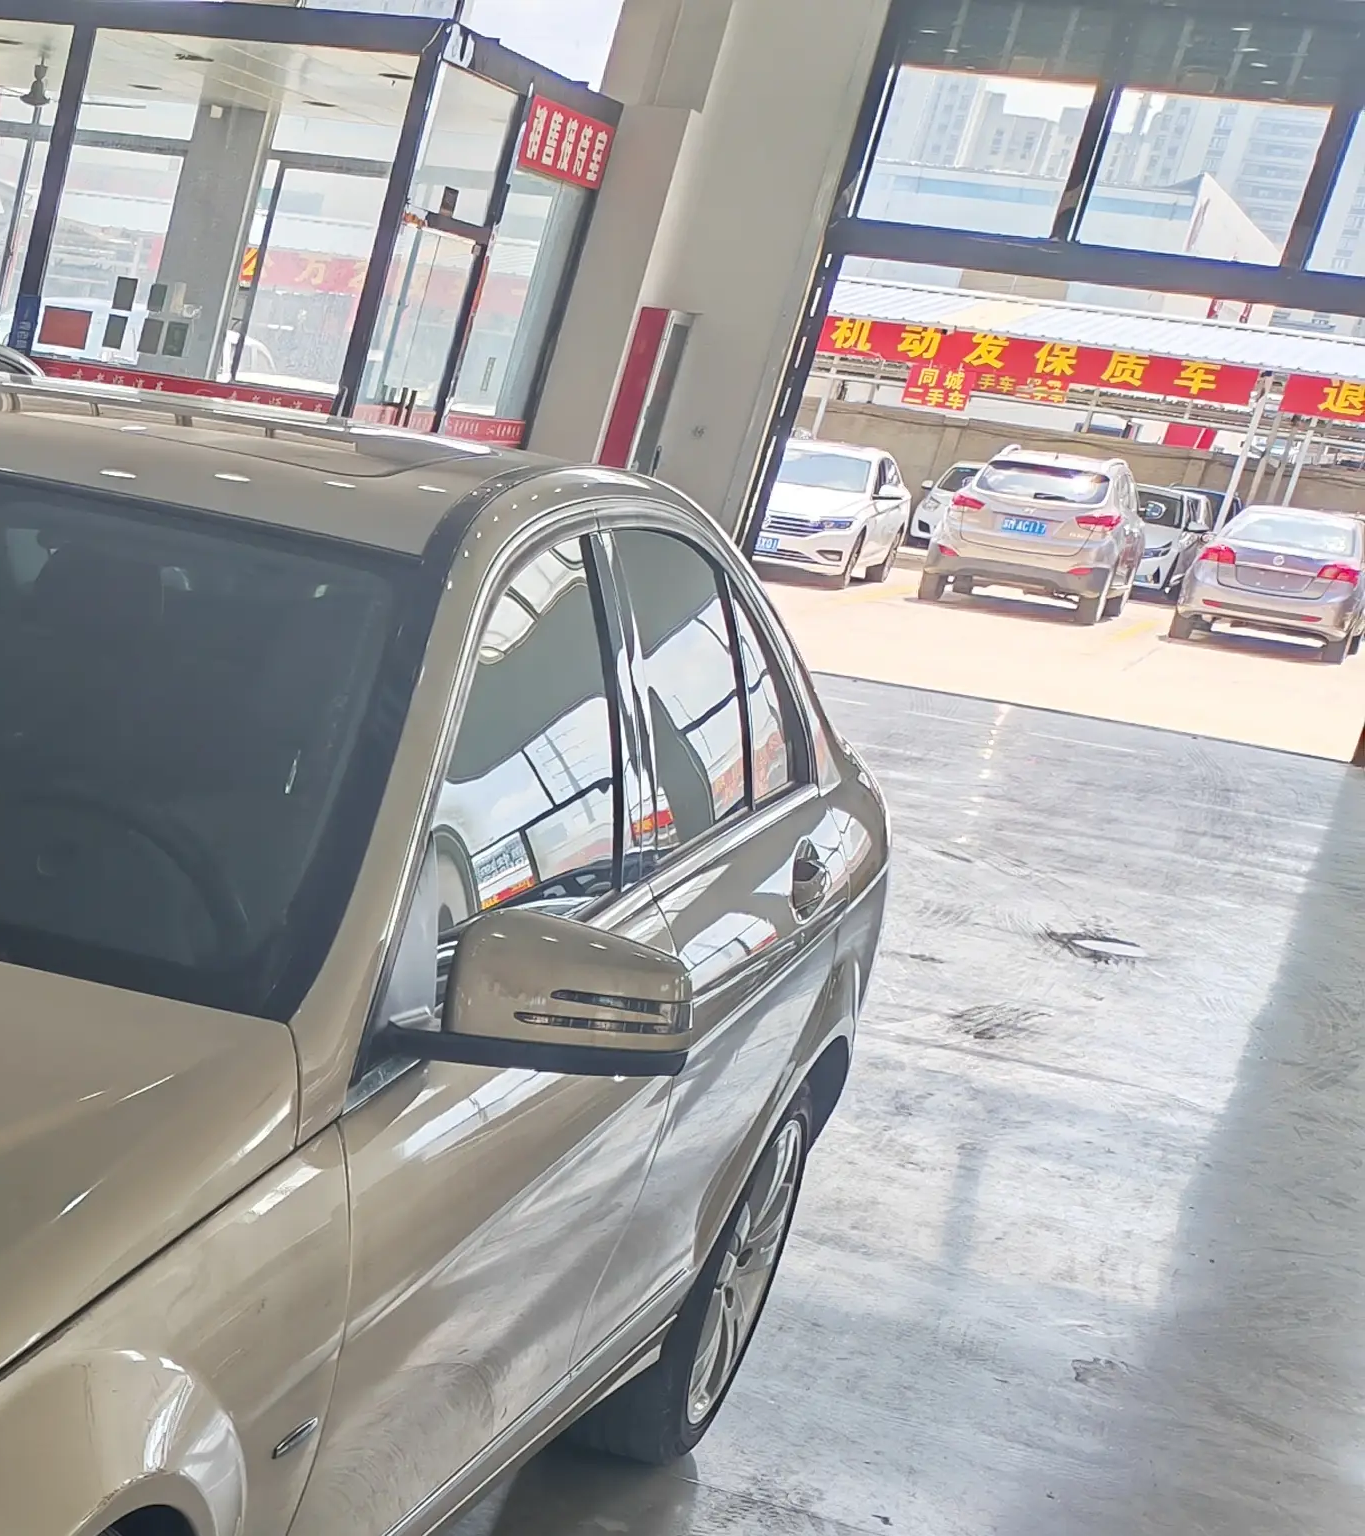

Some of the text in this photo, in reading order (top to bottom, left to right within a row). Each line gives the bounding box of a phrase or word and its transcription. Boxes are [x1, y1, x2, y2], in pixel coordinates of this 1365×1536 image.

[526, 104, 608, 182] 销售接待室
[830, 318, 1222, 395] 机动发保质车
[918, 367, 965, 390] 同城
[904, 387, 966, 411] 二手车
